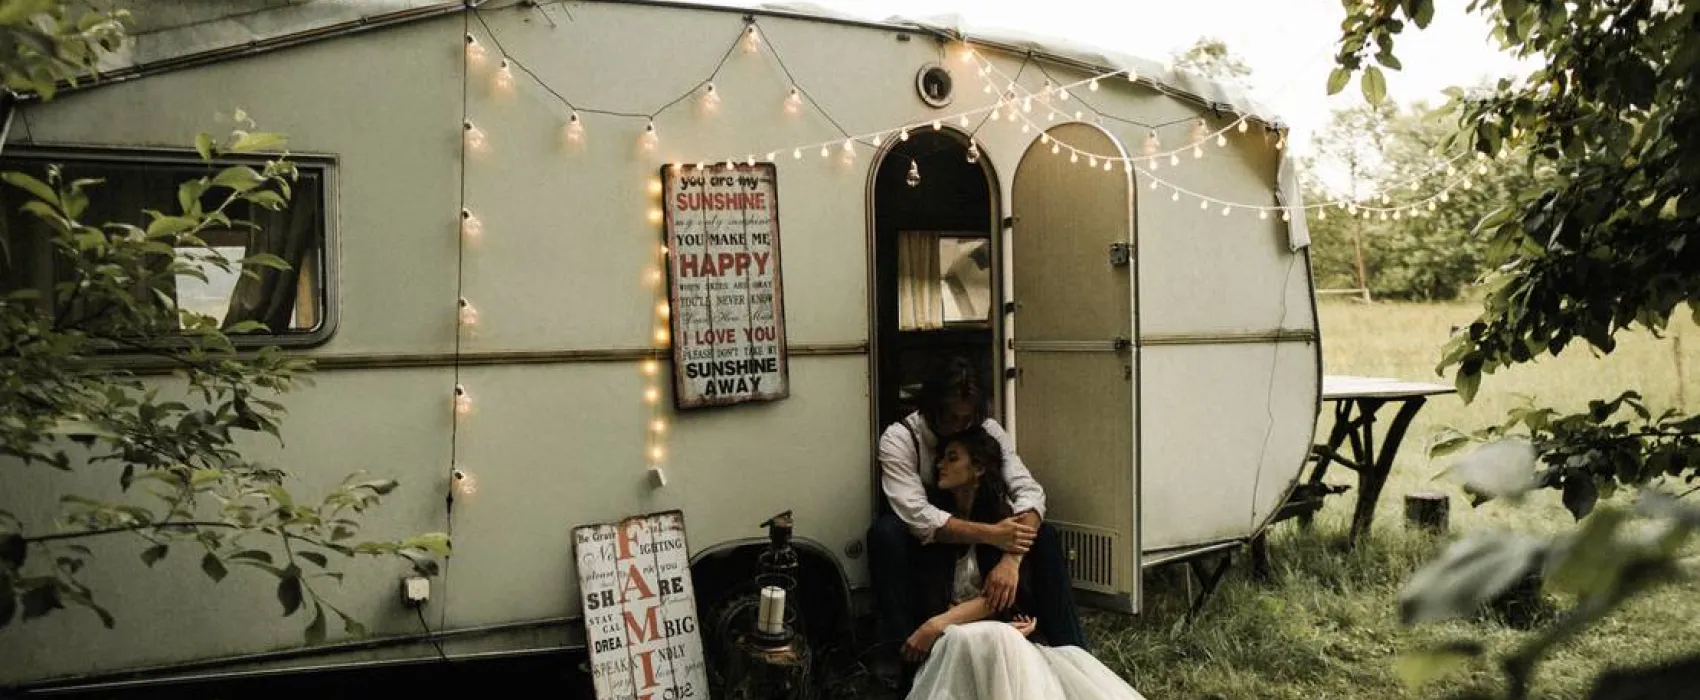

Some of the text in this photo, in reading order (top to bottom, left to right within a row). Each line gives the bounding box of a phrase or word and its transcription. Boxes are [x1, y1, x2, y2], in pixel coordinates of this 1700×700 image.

[680, 176, 759, 190] you are my
[677, 192, 766, 211] SUNSHINE
[677, 233, 771, 246] YOU MAKE ME
[680, 251, 770, 278] HAPPY
[683, 325, 776, 345] I LOVE YOU
[686, 357, 778, 378] SUNSHINE
[705, 376, 762, 396] AWAY
[663, 616, 695, 638] BIG
